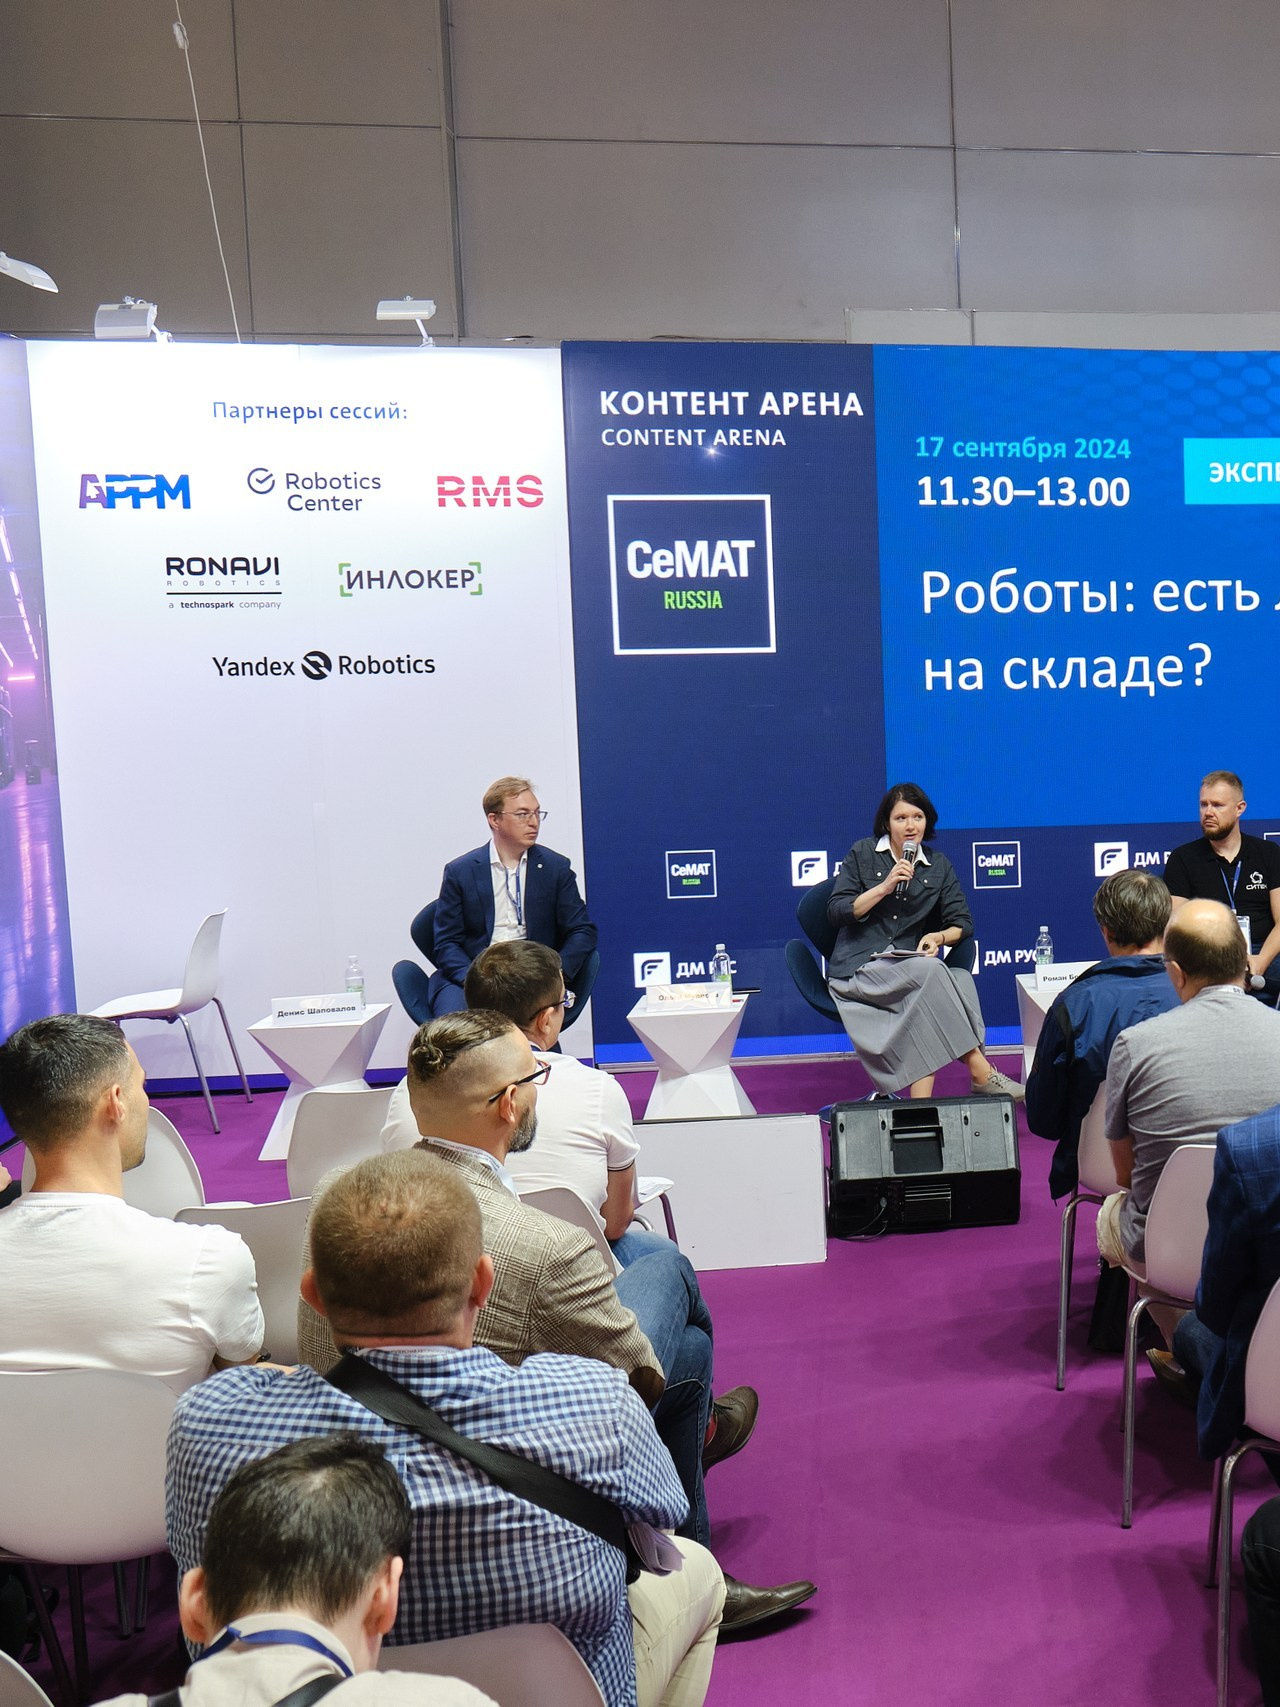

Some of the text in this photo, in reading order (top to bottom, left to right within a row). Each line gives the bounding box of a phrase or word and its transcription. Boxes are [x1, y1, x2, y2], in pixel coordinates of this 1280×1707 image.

[212, 401, 409, 425] Партнеры сессий:
[600, 391, 864, 417] КОНТЕНТ АРЕНА
[601, 428, 787, 447] CONTENT ARENA
[915, 436, 1132, 463] 17 сентября 2024
[285, 472, 382, 491] Robotics
[436, 475, 545, 508] RMS
[287, 494, 363, 512] Center
[165, 556, 280, 576] RONAVI
[626, 540, 756, 579] CeMAT
[166, 579, 281, 587] ROBOTICS
[347, 568, 476, 591] ИНЛОКЕР
[664, 590, 723, 610] RUSSIA
[922, 567, 1136, 615] Роботы:
[1152, 577, 1261, 612] есть
[180, 600, 235, 610] technospark
[239, 600, 281, 610] company
[212, 654, 436, 677] Yandex Robotics
[925, 642, 1213, 698] на складе?
[978, 854, 1016, 868] CeMAT
[1133, 851, 1161, 868] ДМ
[671, 863, 711, 877] CeMAT
[984, 950, 1011, 967] ДМ
[675, 961, 706, 979] ДМ
[277, 1005, 357, 1019] Денис Шаповалов
